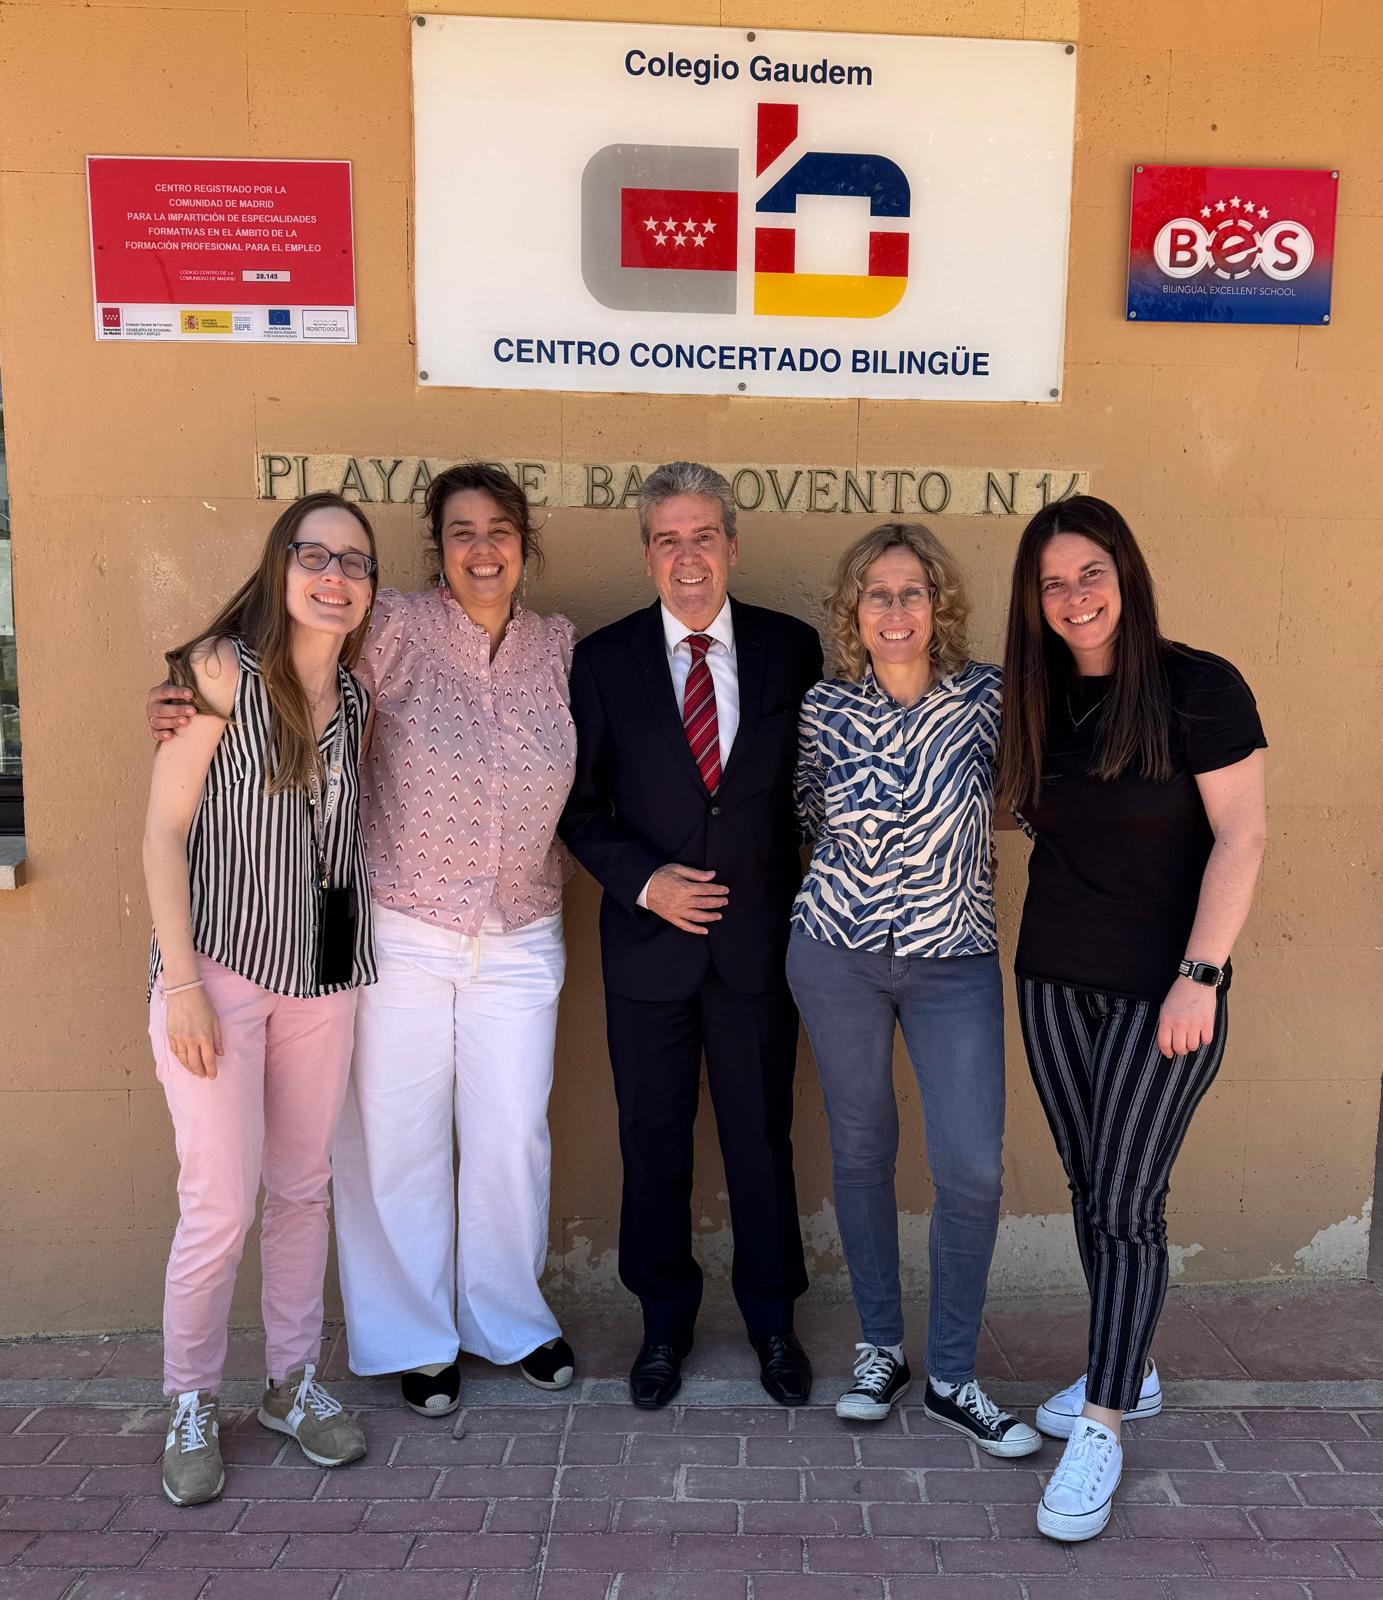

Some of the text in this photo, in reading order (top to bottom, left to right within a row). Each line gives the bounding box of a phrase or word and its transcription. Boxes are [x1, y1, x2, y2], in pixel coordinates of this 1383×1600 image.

[624, 50, 873, 86] Colegio Gaudem
[154, 184, 192, 192] CENTRO
[194, 184, 252, 193] REGISTRADO
[275, 186, 286, 194] LA
[169, 198, 274, 208] COMUNIDAD DE MADRID
[127, 212, 152, 221] PARA
[168, 212, 224, 222] IMPARTICIÓN
[227, 214, 239, 222] DE
[242, 214, 317, 223] ESPECIALIDADES
[148, 227, 206, 236] FORMATIVAS
[208, 228, 220, 236] EN
[235, 227, 269, 237] ÁMBITO
[125, 240, 179, 250] FORMACIÓN
[181, 242, 243, 251] PROFESIONAL
[245, 243, 270, 251] PARA
[285, 244, 322, 253] EMPLEO
[1163, 285, 1296, 296] BILINGUAL EXCELLENT SCHOOL
[493, 337, 990, 377] CENTRO CONCERTADO BILINGÜE
[583, 464, 951, 514] BAOVENTO
[983, 472, 1020, 515] N
